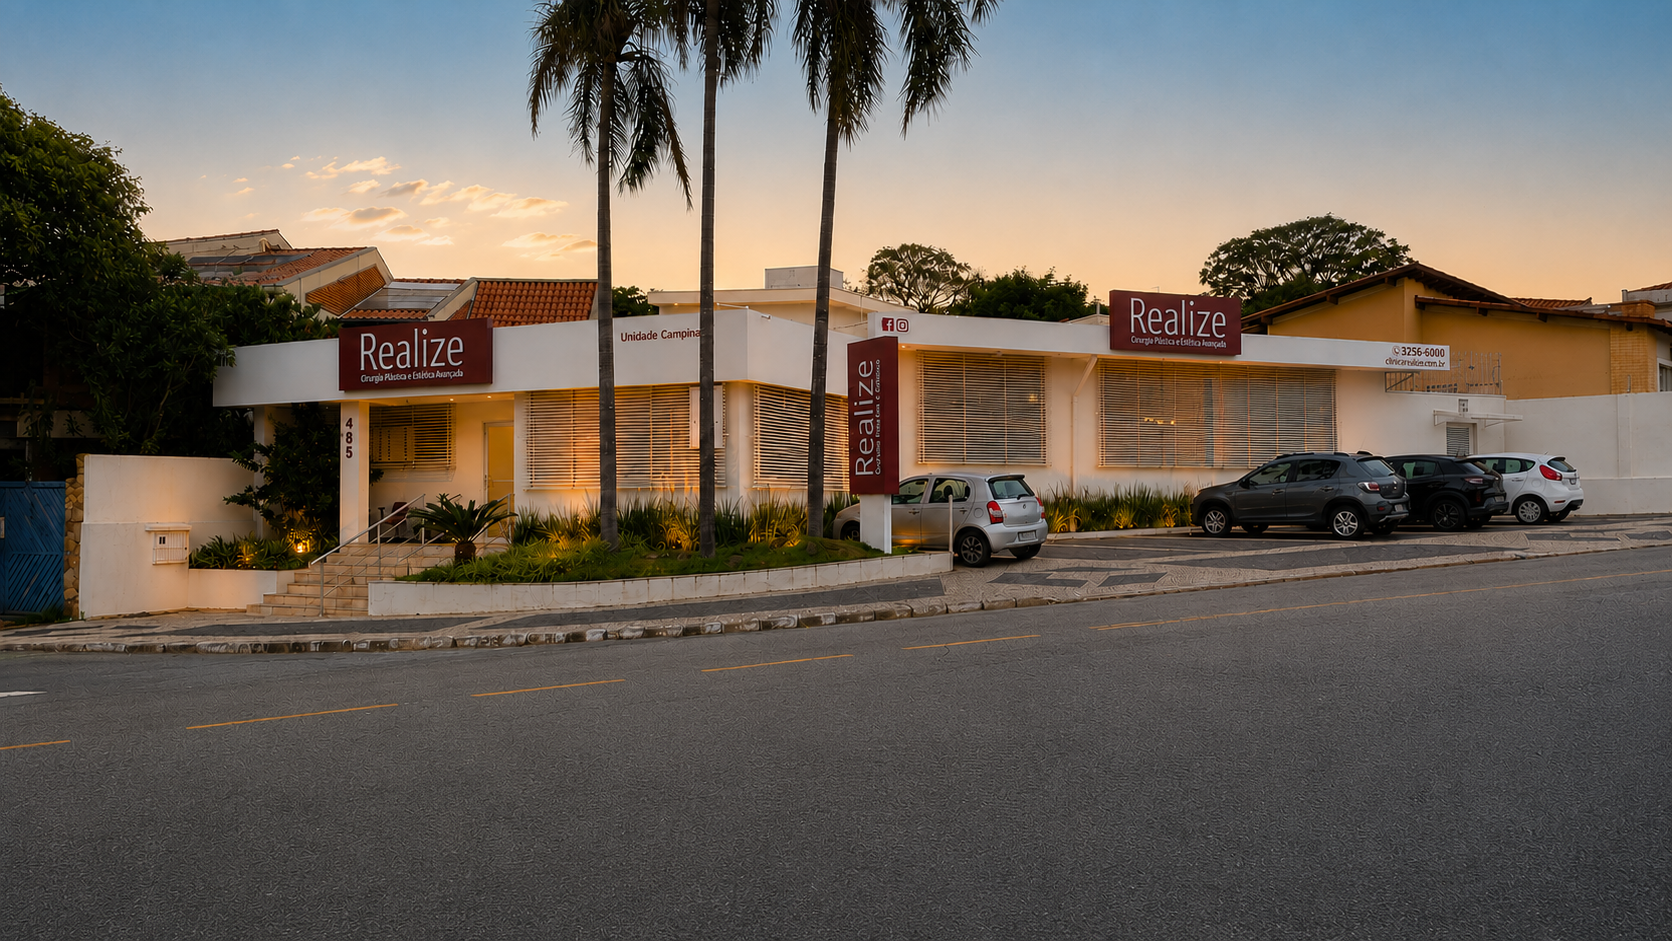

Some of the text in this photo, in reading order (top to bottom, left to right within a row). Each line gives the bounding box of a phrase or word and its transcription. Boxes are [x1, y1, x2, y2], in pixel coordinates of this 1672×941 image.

[620, 328, 701, 342] Unidade Campina
[1130, 297, 1226, 338] Realize
[360, 328, 464, 370] Realize
[1401, 346, 1445, 357] 3256-6000
[345, 417, 354, 459] 485
[854, 360, 874, 476] Realize
